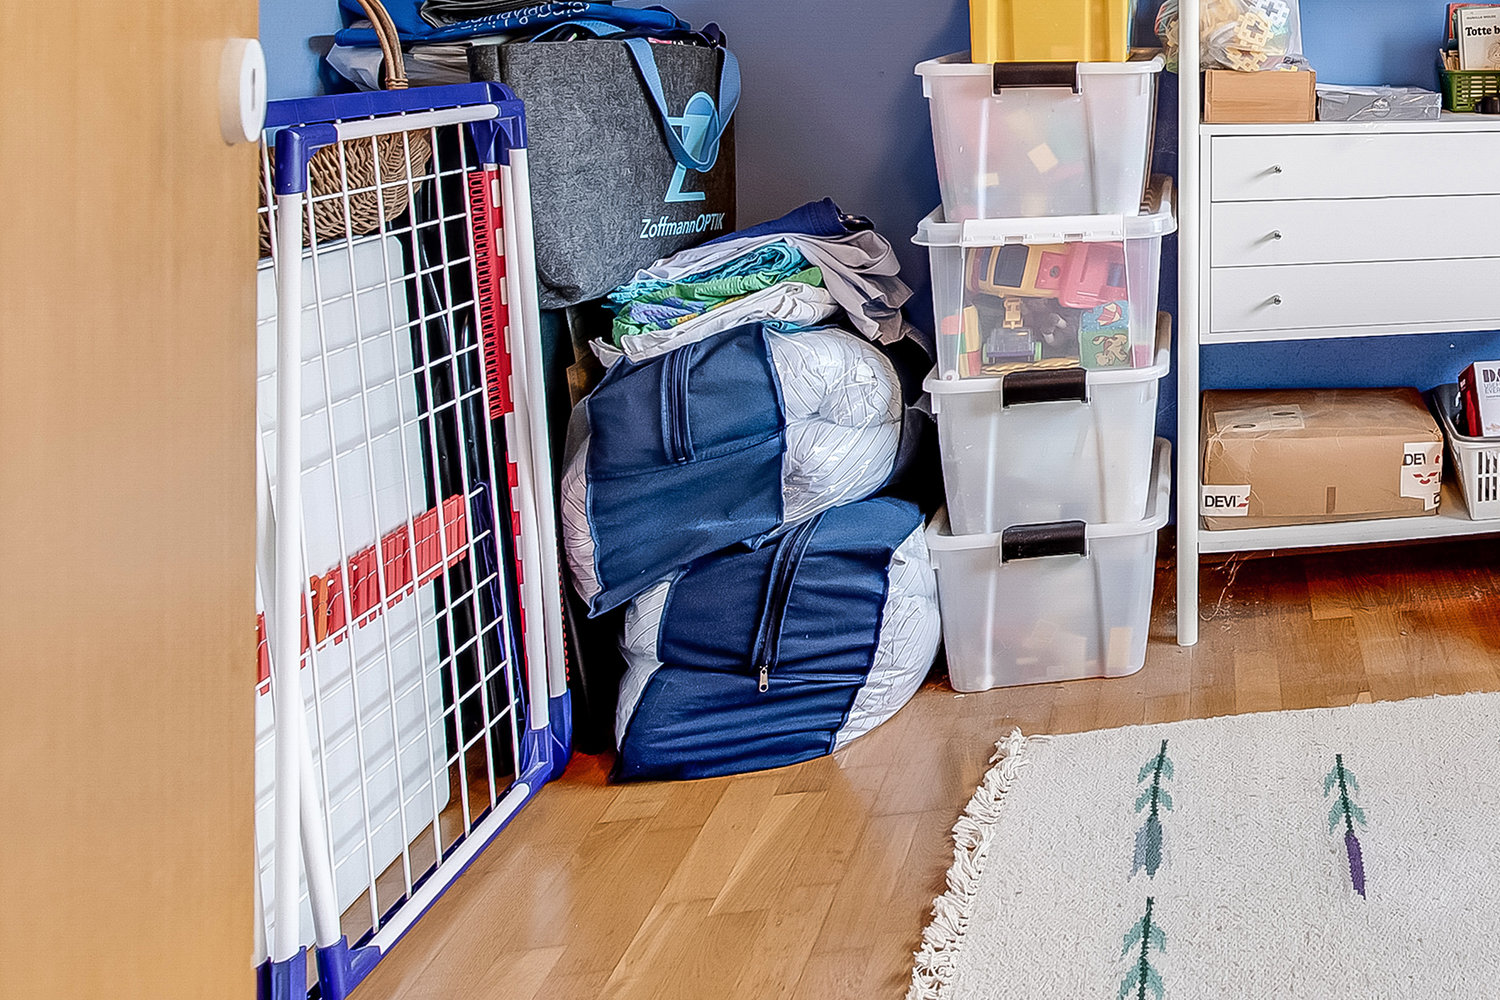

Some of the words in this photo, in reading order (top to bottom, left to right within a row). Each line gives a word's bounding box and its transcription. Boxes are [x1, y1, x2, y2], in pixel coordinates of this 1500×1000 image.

[1465, 26, 1492, 37] Totte
[640, 212, 726, 239] ZoffmannOPTIK
[1204, 495, 1236, 508] DEVI
